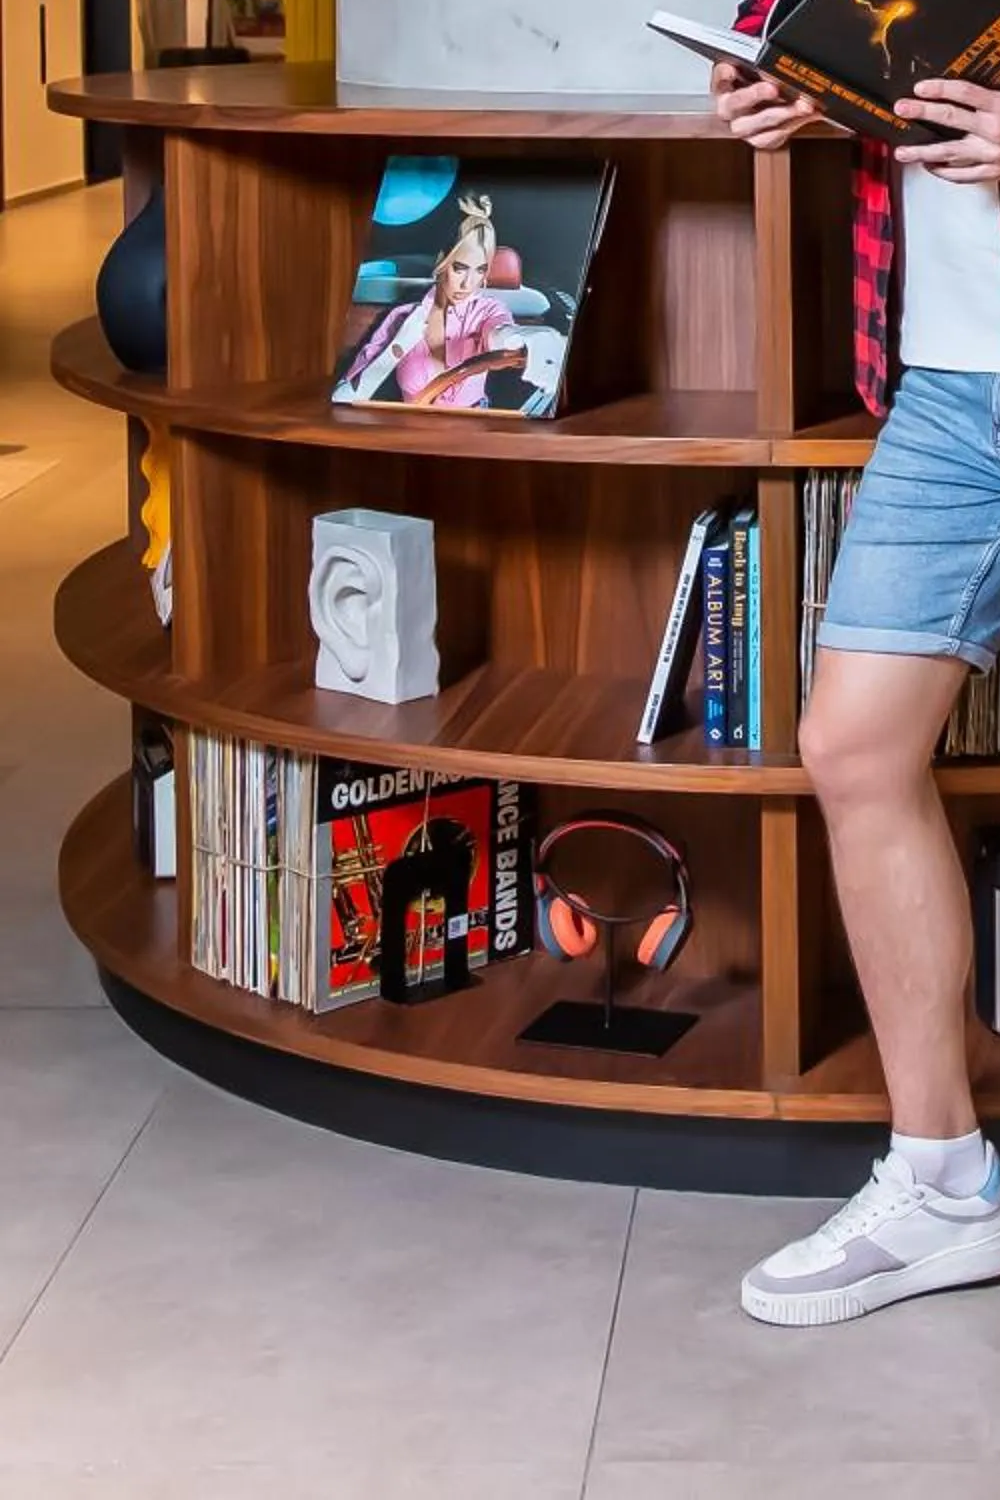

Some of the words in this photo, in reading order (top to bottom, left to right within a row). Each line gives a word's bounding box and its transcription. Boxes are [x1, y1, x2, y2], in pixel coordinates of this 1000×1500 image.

[707, 573, 723, 645] ALBUM
[707, 653, 723, 692] ART
[331, 768, 425, 810] GOLDEN
[495, 848, 518, 951] BANDS
